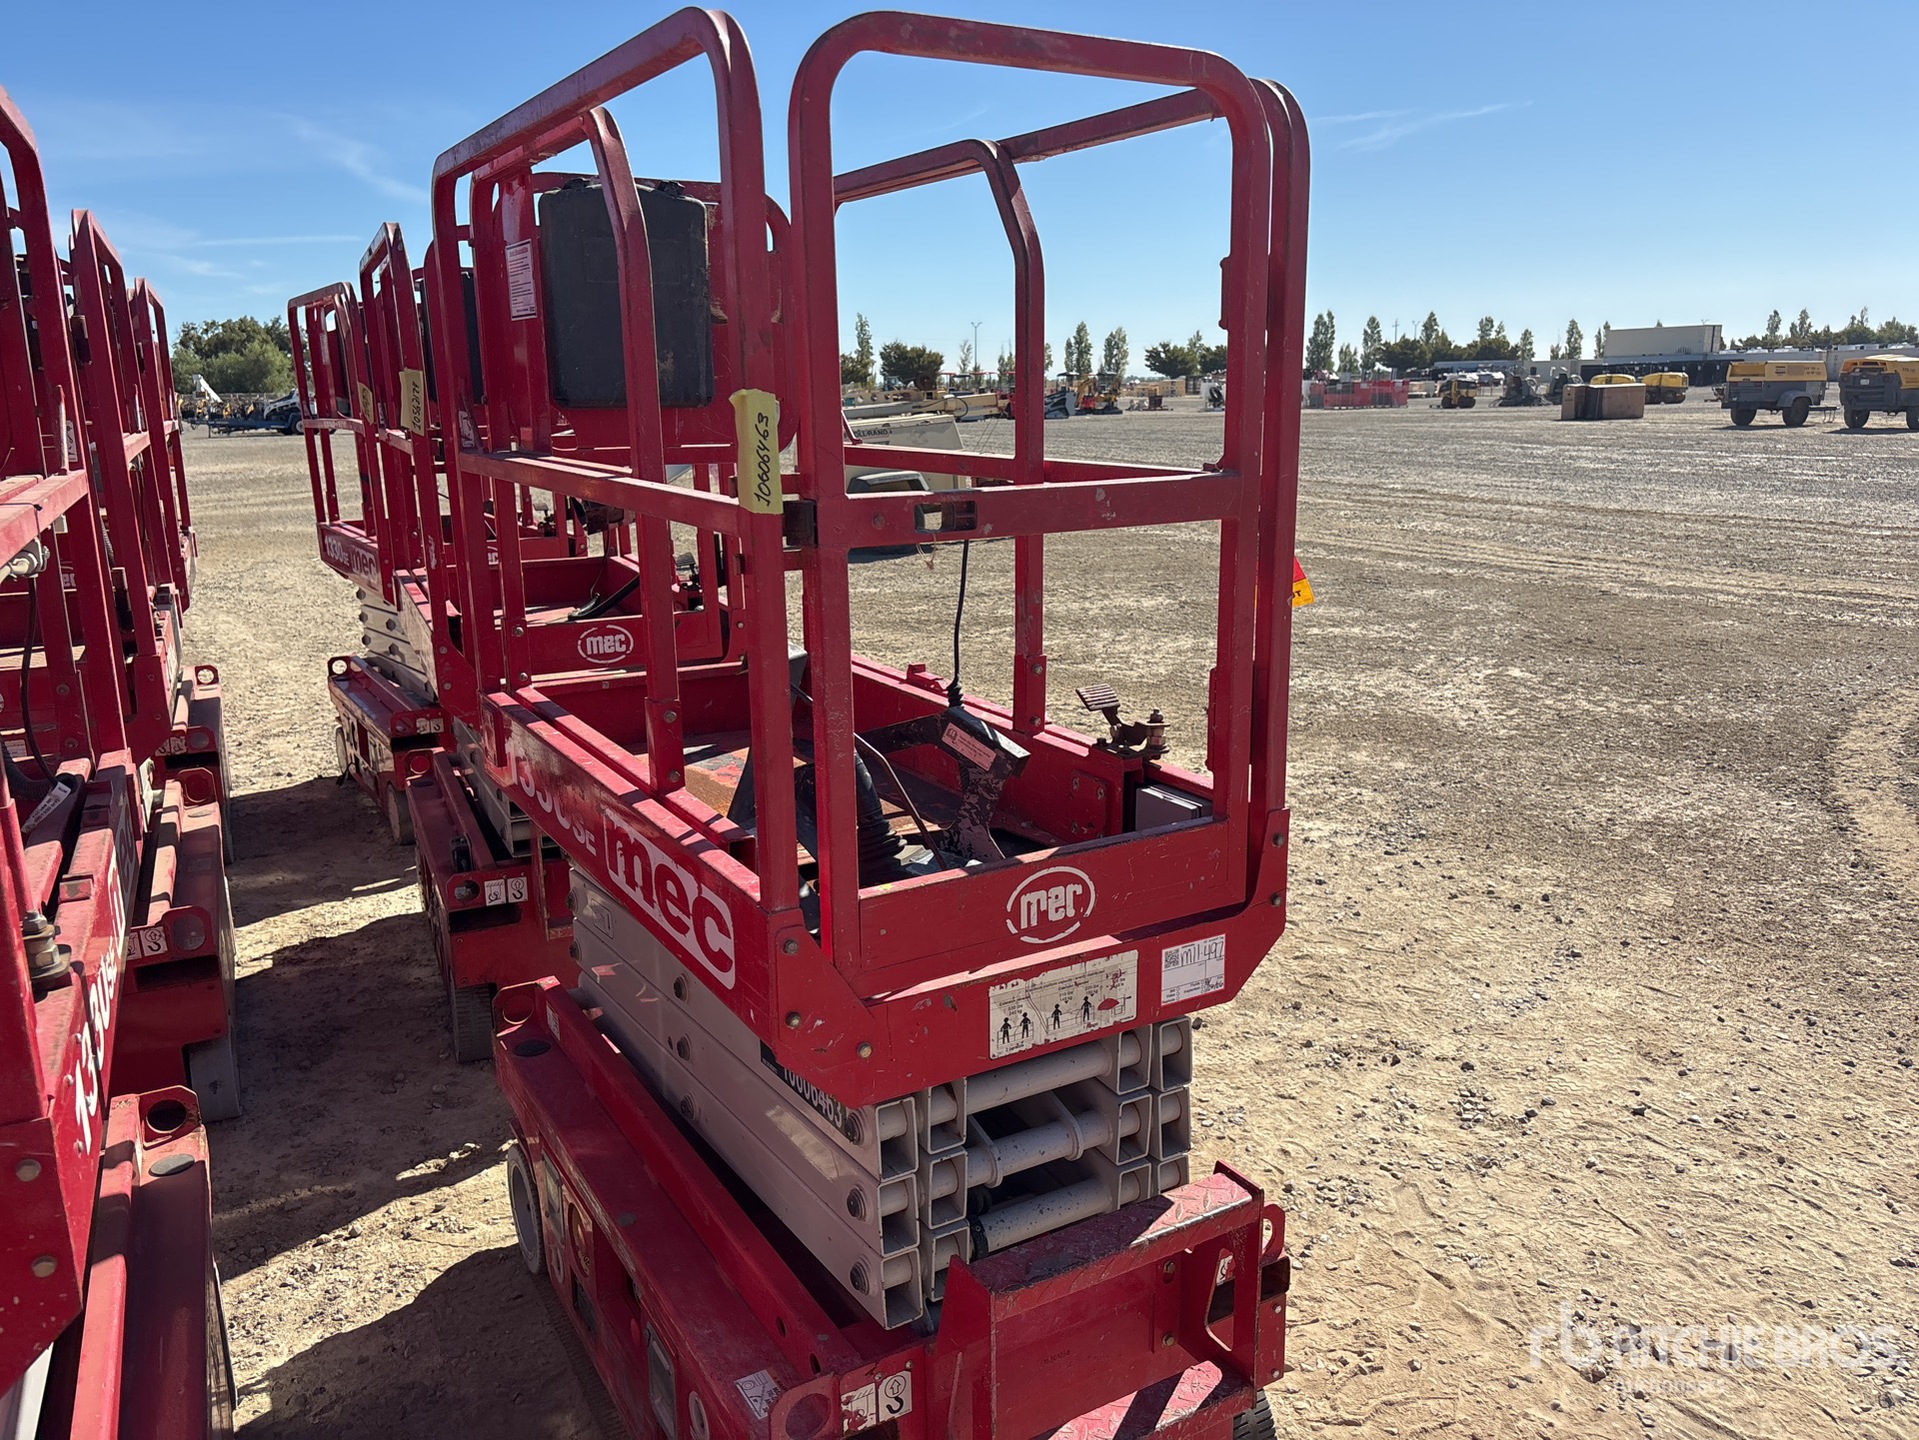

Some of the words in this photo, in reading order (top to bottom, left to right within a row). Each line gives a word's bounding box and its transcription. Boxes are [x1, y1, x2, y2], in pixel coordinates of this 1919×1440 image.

[753, 412, 772, 507] 10606463
[586, 634, 627, 655] mec
[604, 810, 736, 988] mec
